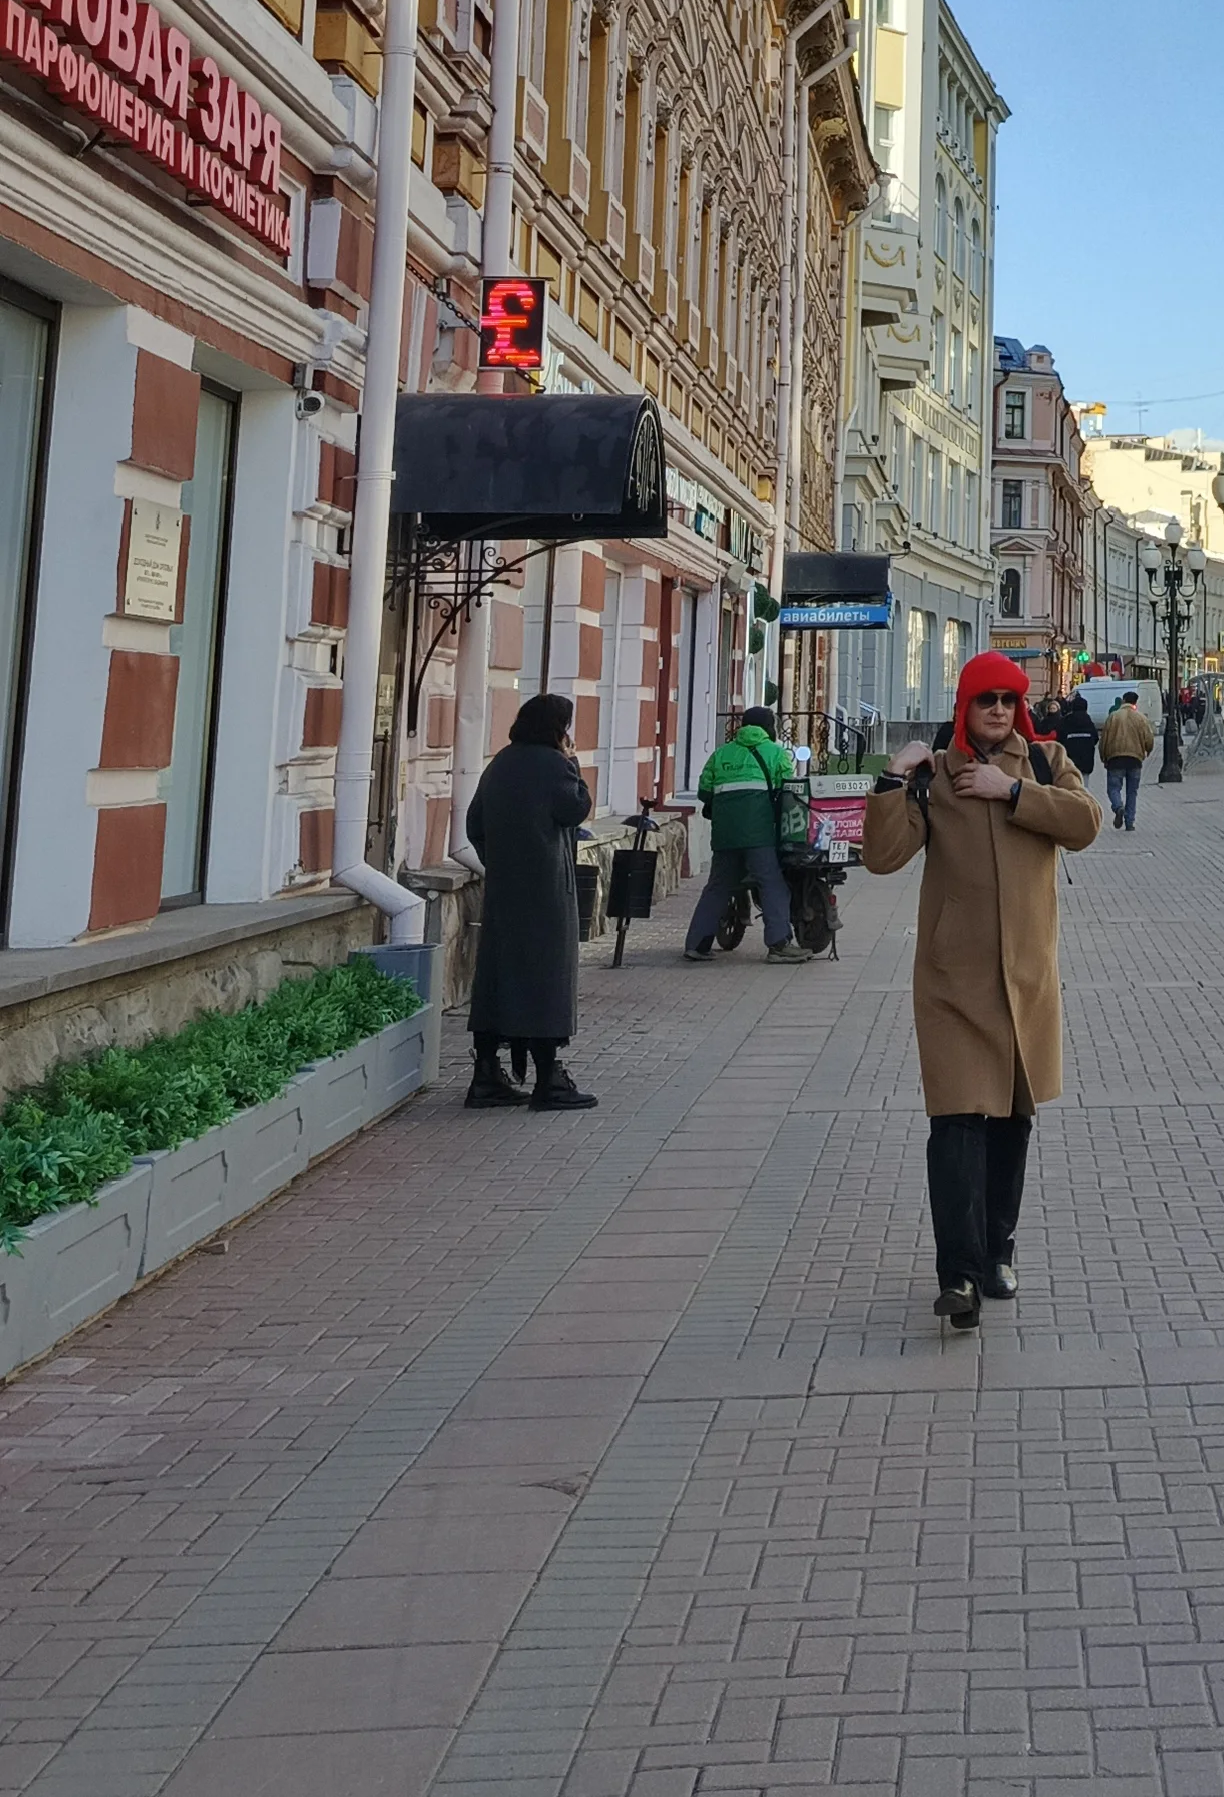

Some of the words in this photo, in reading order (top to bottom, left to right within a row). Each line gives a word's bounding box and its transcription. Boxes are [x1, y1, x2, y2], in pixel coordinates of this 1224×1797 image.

[200, 56, 282, 194] ЗАРЯ
[181, 131, 194, 179] И
[200, 145, 293, 253] КОСМЕТИКА
[783, 609, 870, 622] авиабилеты
